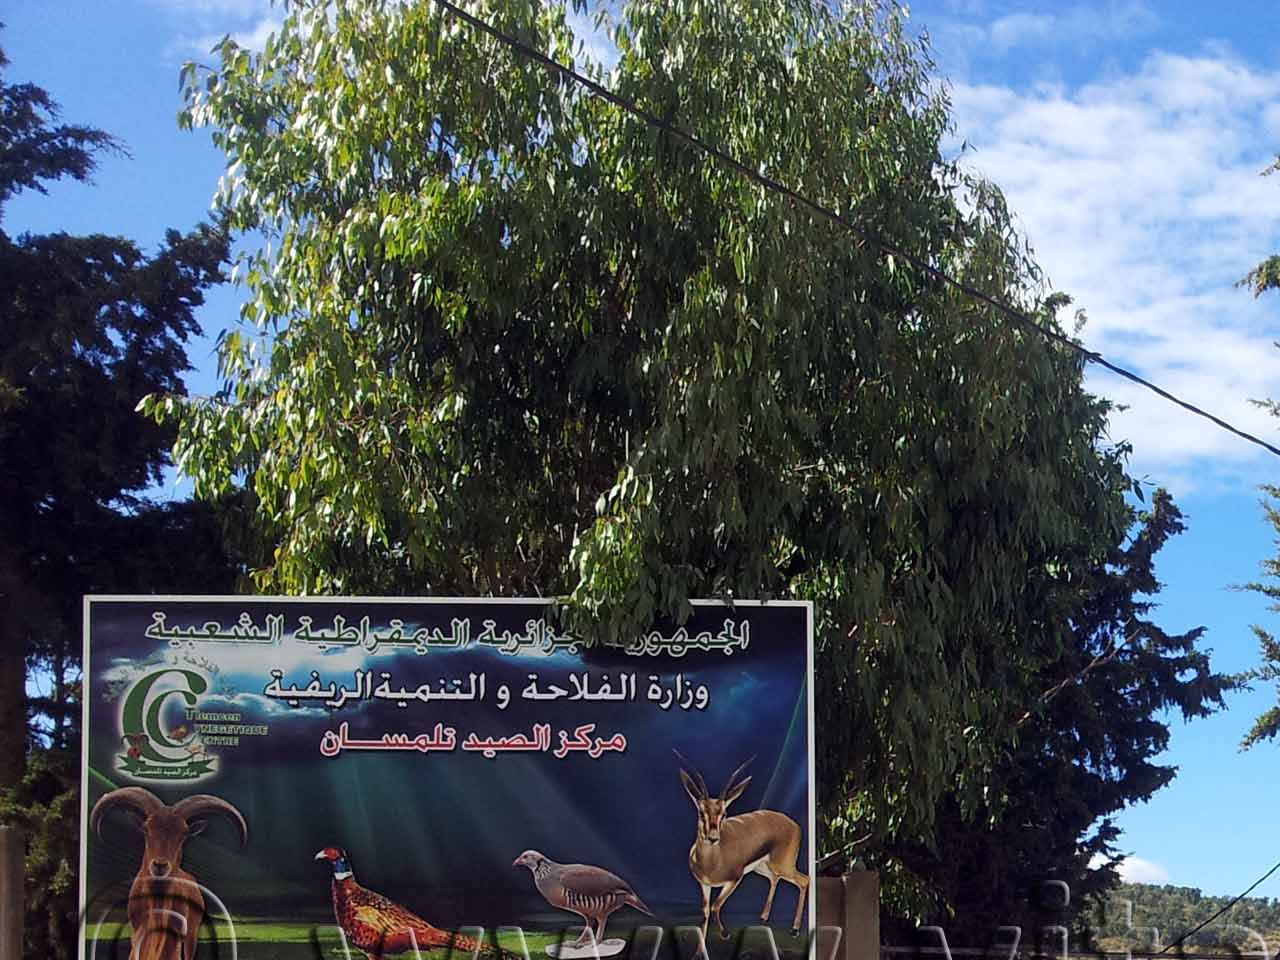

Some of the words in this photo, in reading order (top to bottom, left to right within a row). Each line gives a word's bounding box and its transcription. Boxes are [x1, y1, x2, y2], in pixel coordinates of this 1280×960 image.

[145, 612, 284, 649] الشعبية
[295, 614, 471, 655] الديمقراطية
[478, 616, 594, 655] جزائرية
[603, 617, 750, 655] الجمهور
[264, 669, 373, 709] الريفية
[374, 671, 487, 707] التنمية
[496, 682, 511, 709] و
[521, 671, 637, 701] الفلاحة
[647, 672, 710, 710] وزارة
[319, 721, 457, 757] تلمسان
[462, 723, 552, 759] الصيد
[554, 723, 628, 759] مركز
